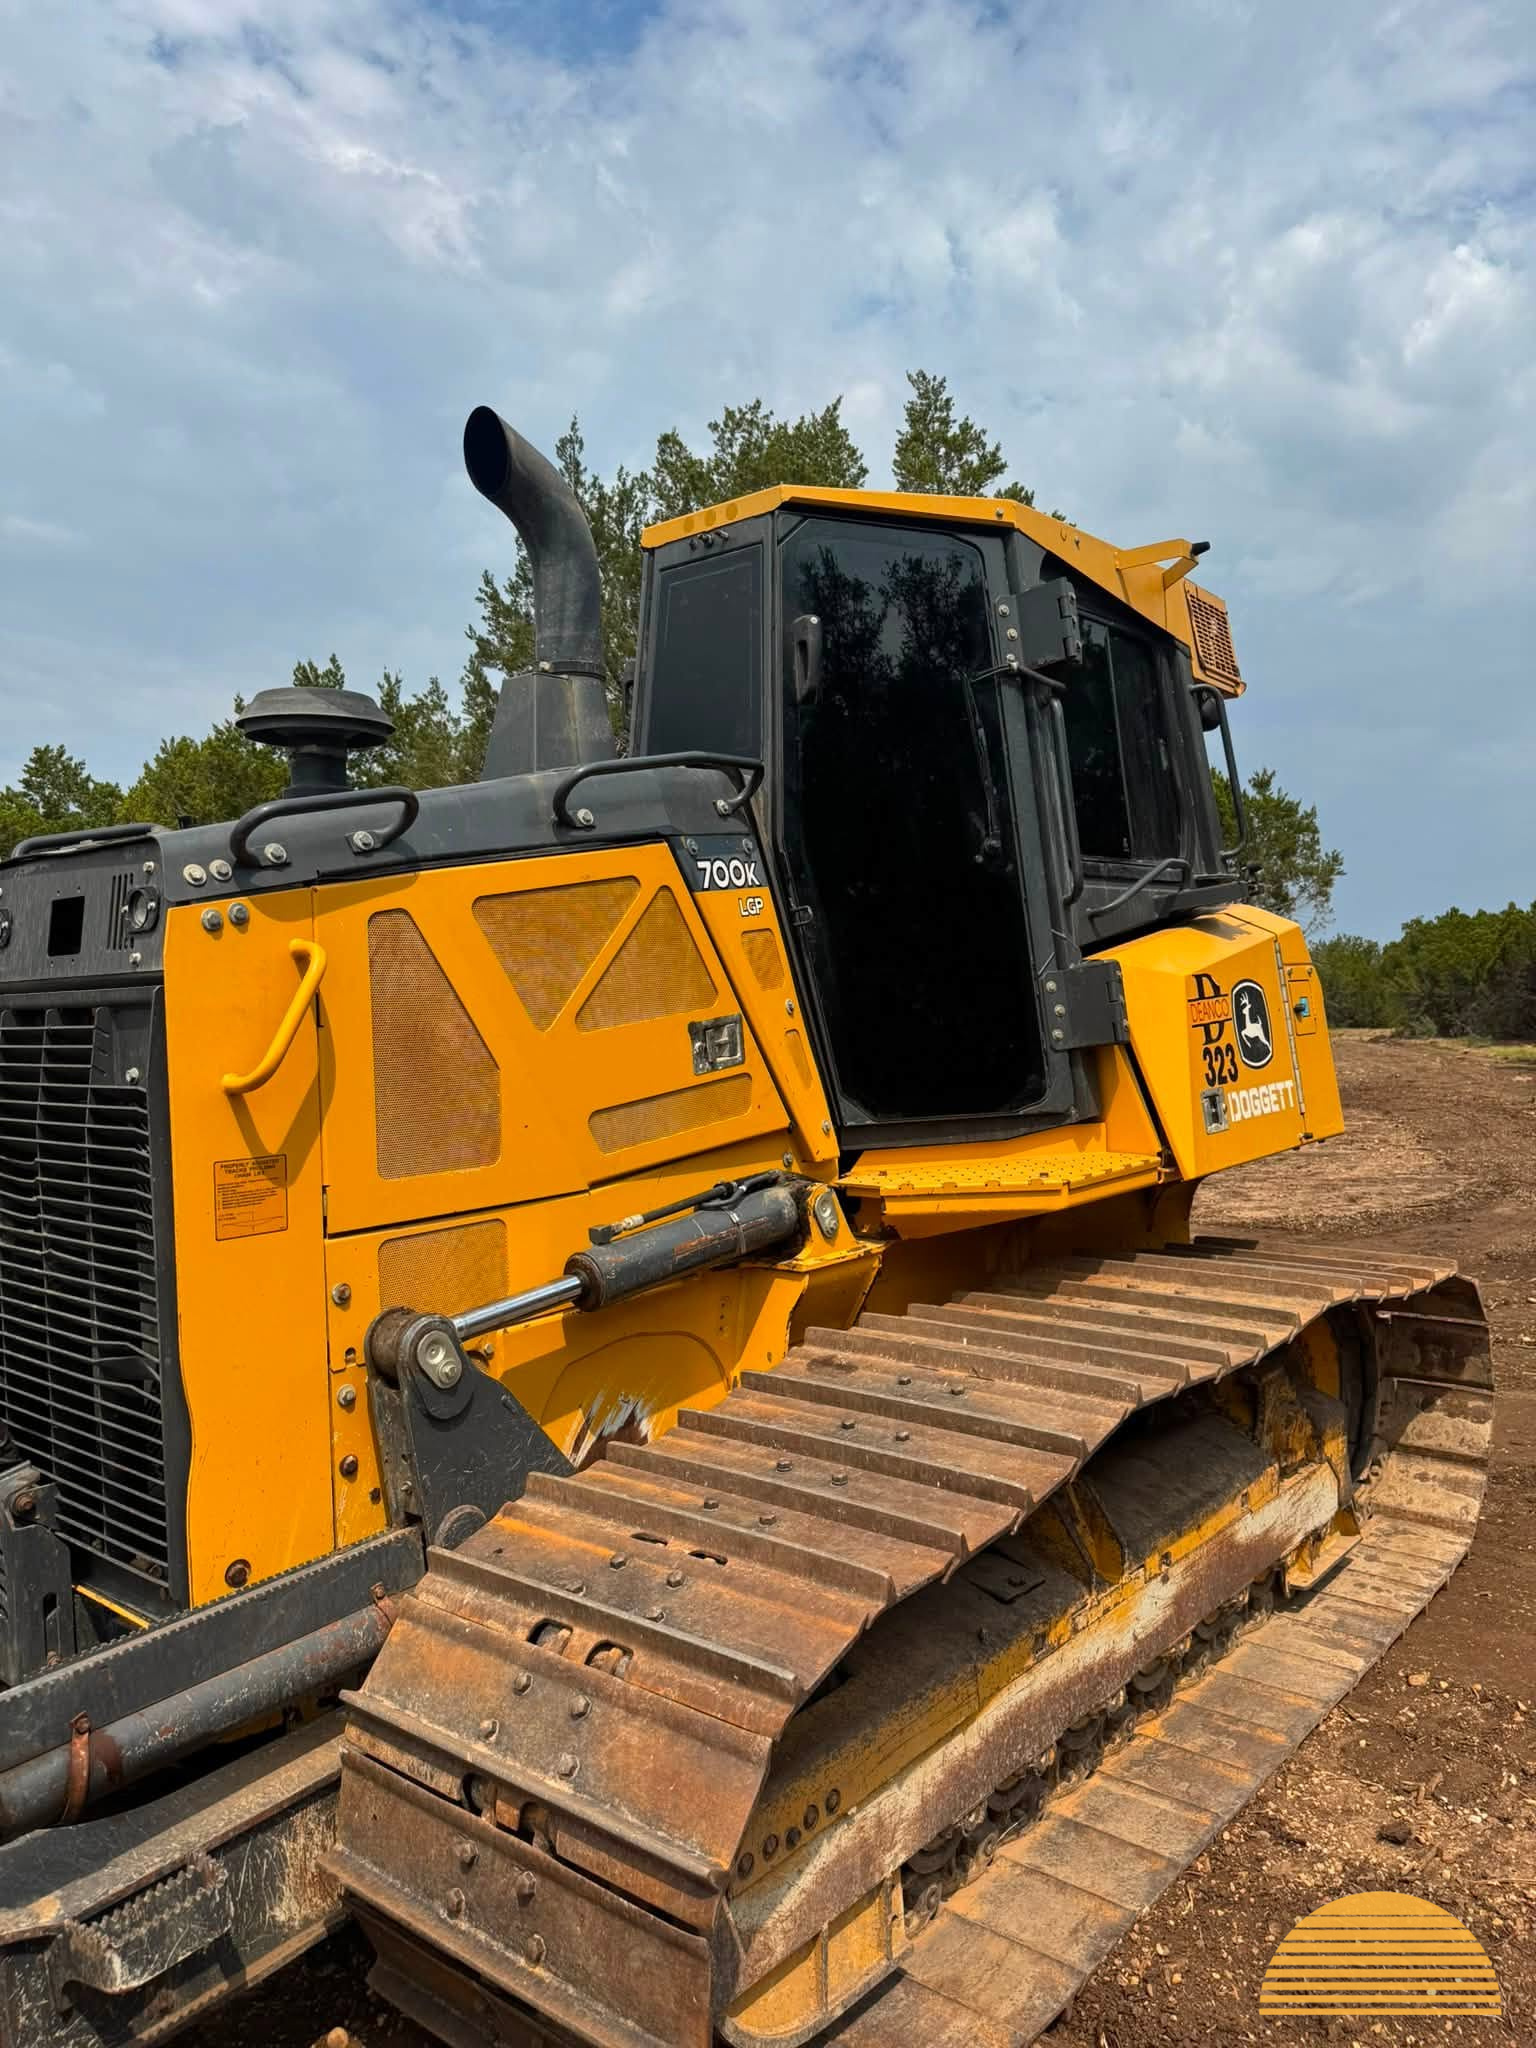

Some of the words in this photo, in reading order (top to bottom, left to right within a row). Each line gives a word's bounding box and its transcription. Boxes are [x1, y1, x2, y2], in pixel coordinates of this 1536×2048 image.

[697, 858, 760, 889] 700K
[739, 896, 764, 917] LGP
[1189, 998, 1230, 1023] DEANCO
[1203, 1043, 1239, 1087] 323
[1227, 1079, 1295, 1122] DOGGETT
